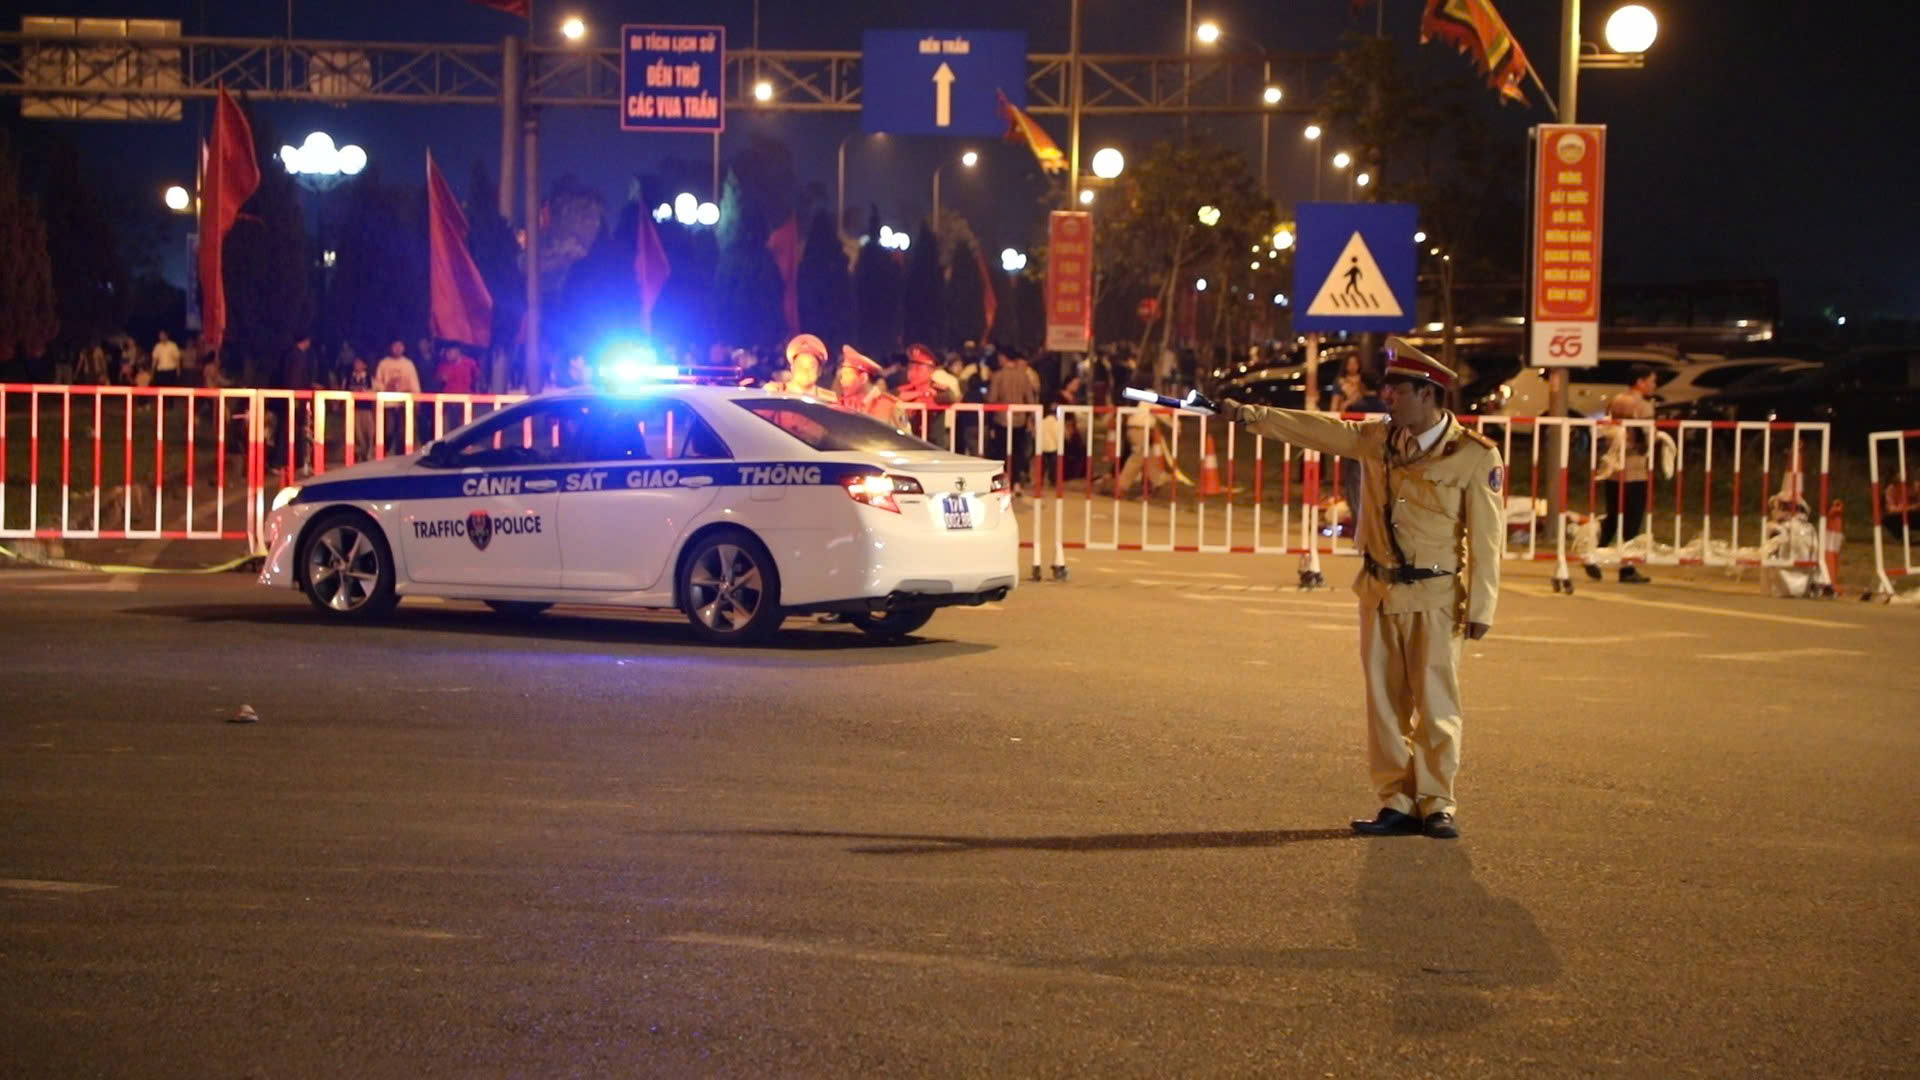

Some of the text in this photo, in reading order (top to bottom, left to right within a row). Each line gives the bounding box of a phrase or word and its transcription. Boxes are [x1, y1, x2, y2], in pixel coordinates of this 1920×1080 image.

[628, 91, 655, 117] CÁC
[656, 95, 682, 118] VUA
[1549, 335, 1582, 358] 5G
[463, 463, 821, 495] CẢNH SÁT GIAO THÔNG
[413, 516, 542, 538] TRAFFIC POLICE
